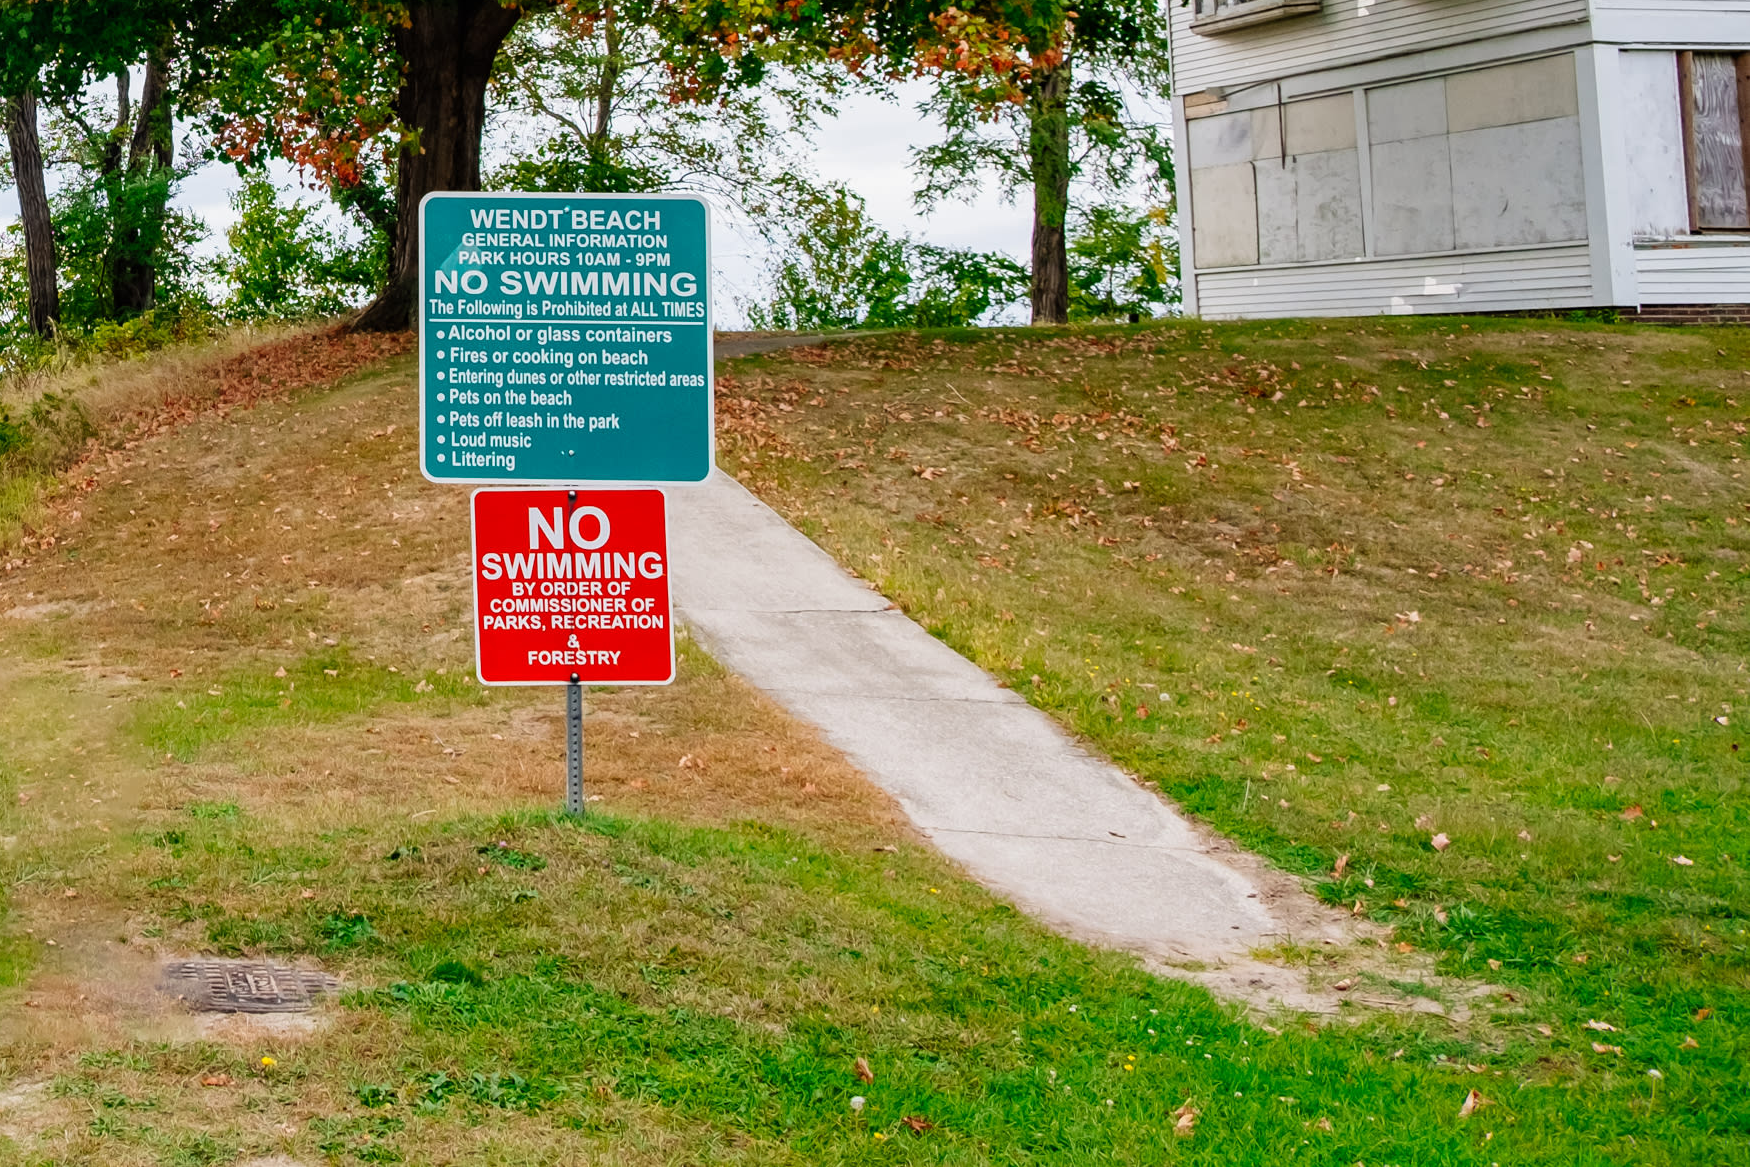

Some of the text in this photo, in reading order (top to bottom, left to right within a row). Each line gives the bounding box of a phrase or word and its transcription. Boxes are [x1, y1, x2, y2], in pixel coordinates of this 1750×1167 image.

[471, 209, 660, 230] WENDT BEACH
[462, 233, 667, 248] GENERAL INFORMATION
[459, 252, 504, 265] PARK
[510, 252, 570, 266] HOURS
[576, 253, 620, 266] 10AM
[636, 253, 670, 266] 9PM
[435, 270, 697, 296] NO SWIMMING
[430, 300, 704, 319] The Following is Prohibited at ALL TIMES
[449, 326, 672, 345] Alcohol or glass containers
[451, 348, 648, 367] Fires or cooking on beach
[450, 368, 704, 387] Entering dunes or other restricted areas
[450, 390, 572, 405] Pets on the beach
[450, 412, 620, 432] Pets off leash in the park
[452, 433, 531, 448] Loud music
[452, 452, 515, 470] Littering
[529, 506, 611, 550] NO
[482, 552, 663, 580] SWIMMING
[512, 582, 630, 595] BY ORDER OF
[490, 598, 654, 612] COMMISSIONER OF
[484, 615, 663, 631] PARKS, RECREATION
[567, 634, 579, 648] &
[528, 651, 621, 665] FORESTRY
